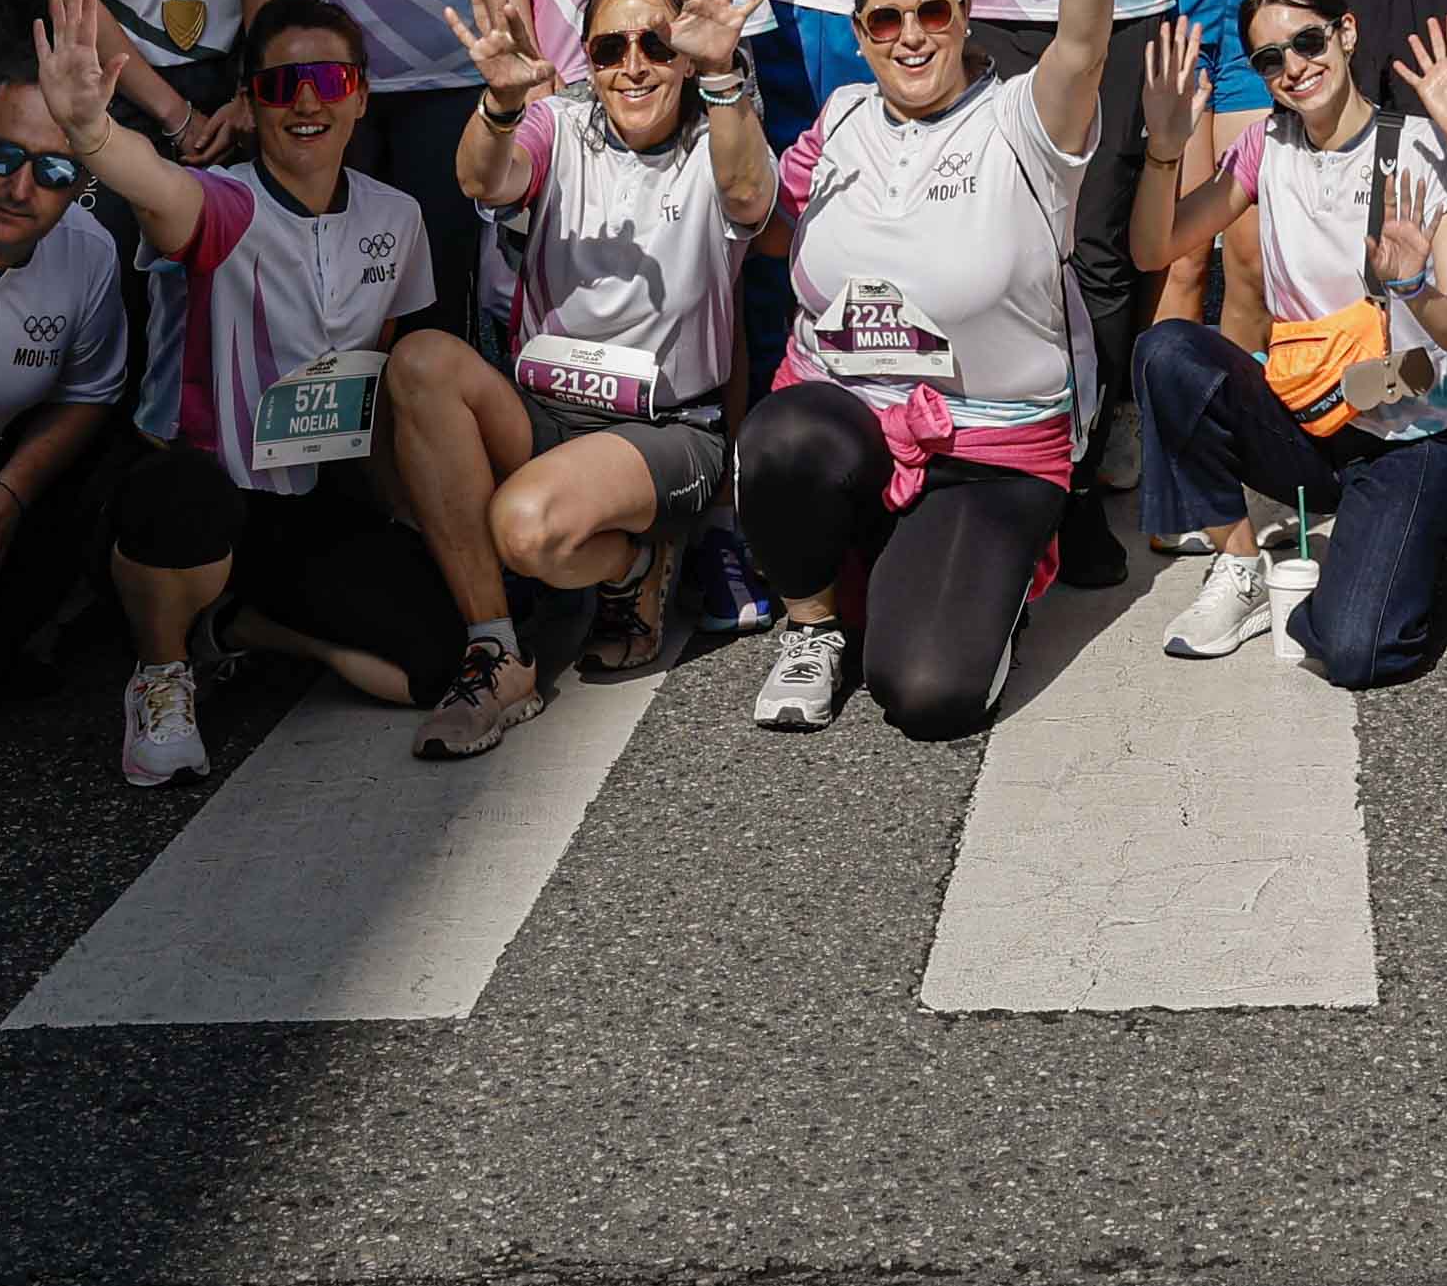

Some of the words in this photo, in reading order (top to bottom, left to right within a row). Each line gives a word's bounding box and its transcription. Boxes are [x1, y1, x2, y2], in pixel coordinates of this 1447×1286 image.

[926, 176, 977, 202] MOU-TE
[857, 330, 910, 347] MARIA
[12, 348, 61, 368] MOU-TE
[551, 368, 618, 401] 2120
[295, 383, 338, 413] 571
[289, 413, 339, 435] NOELIA
